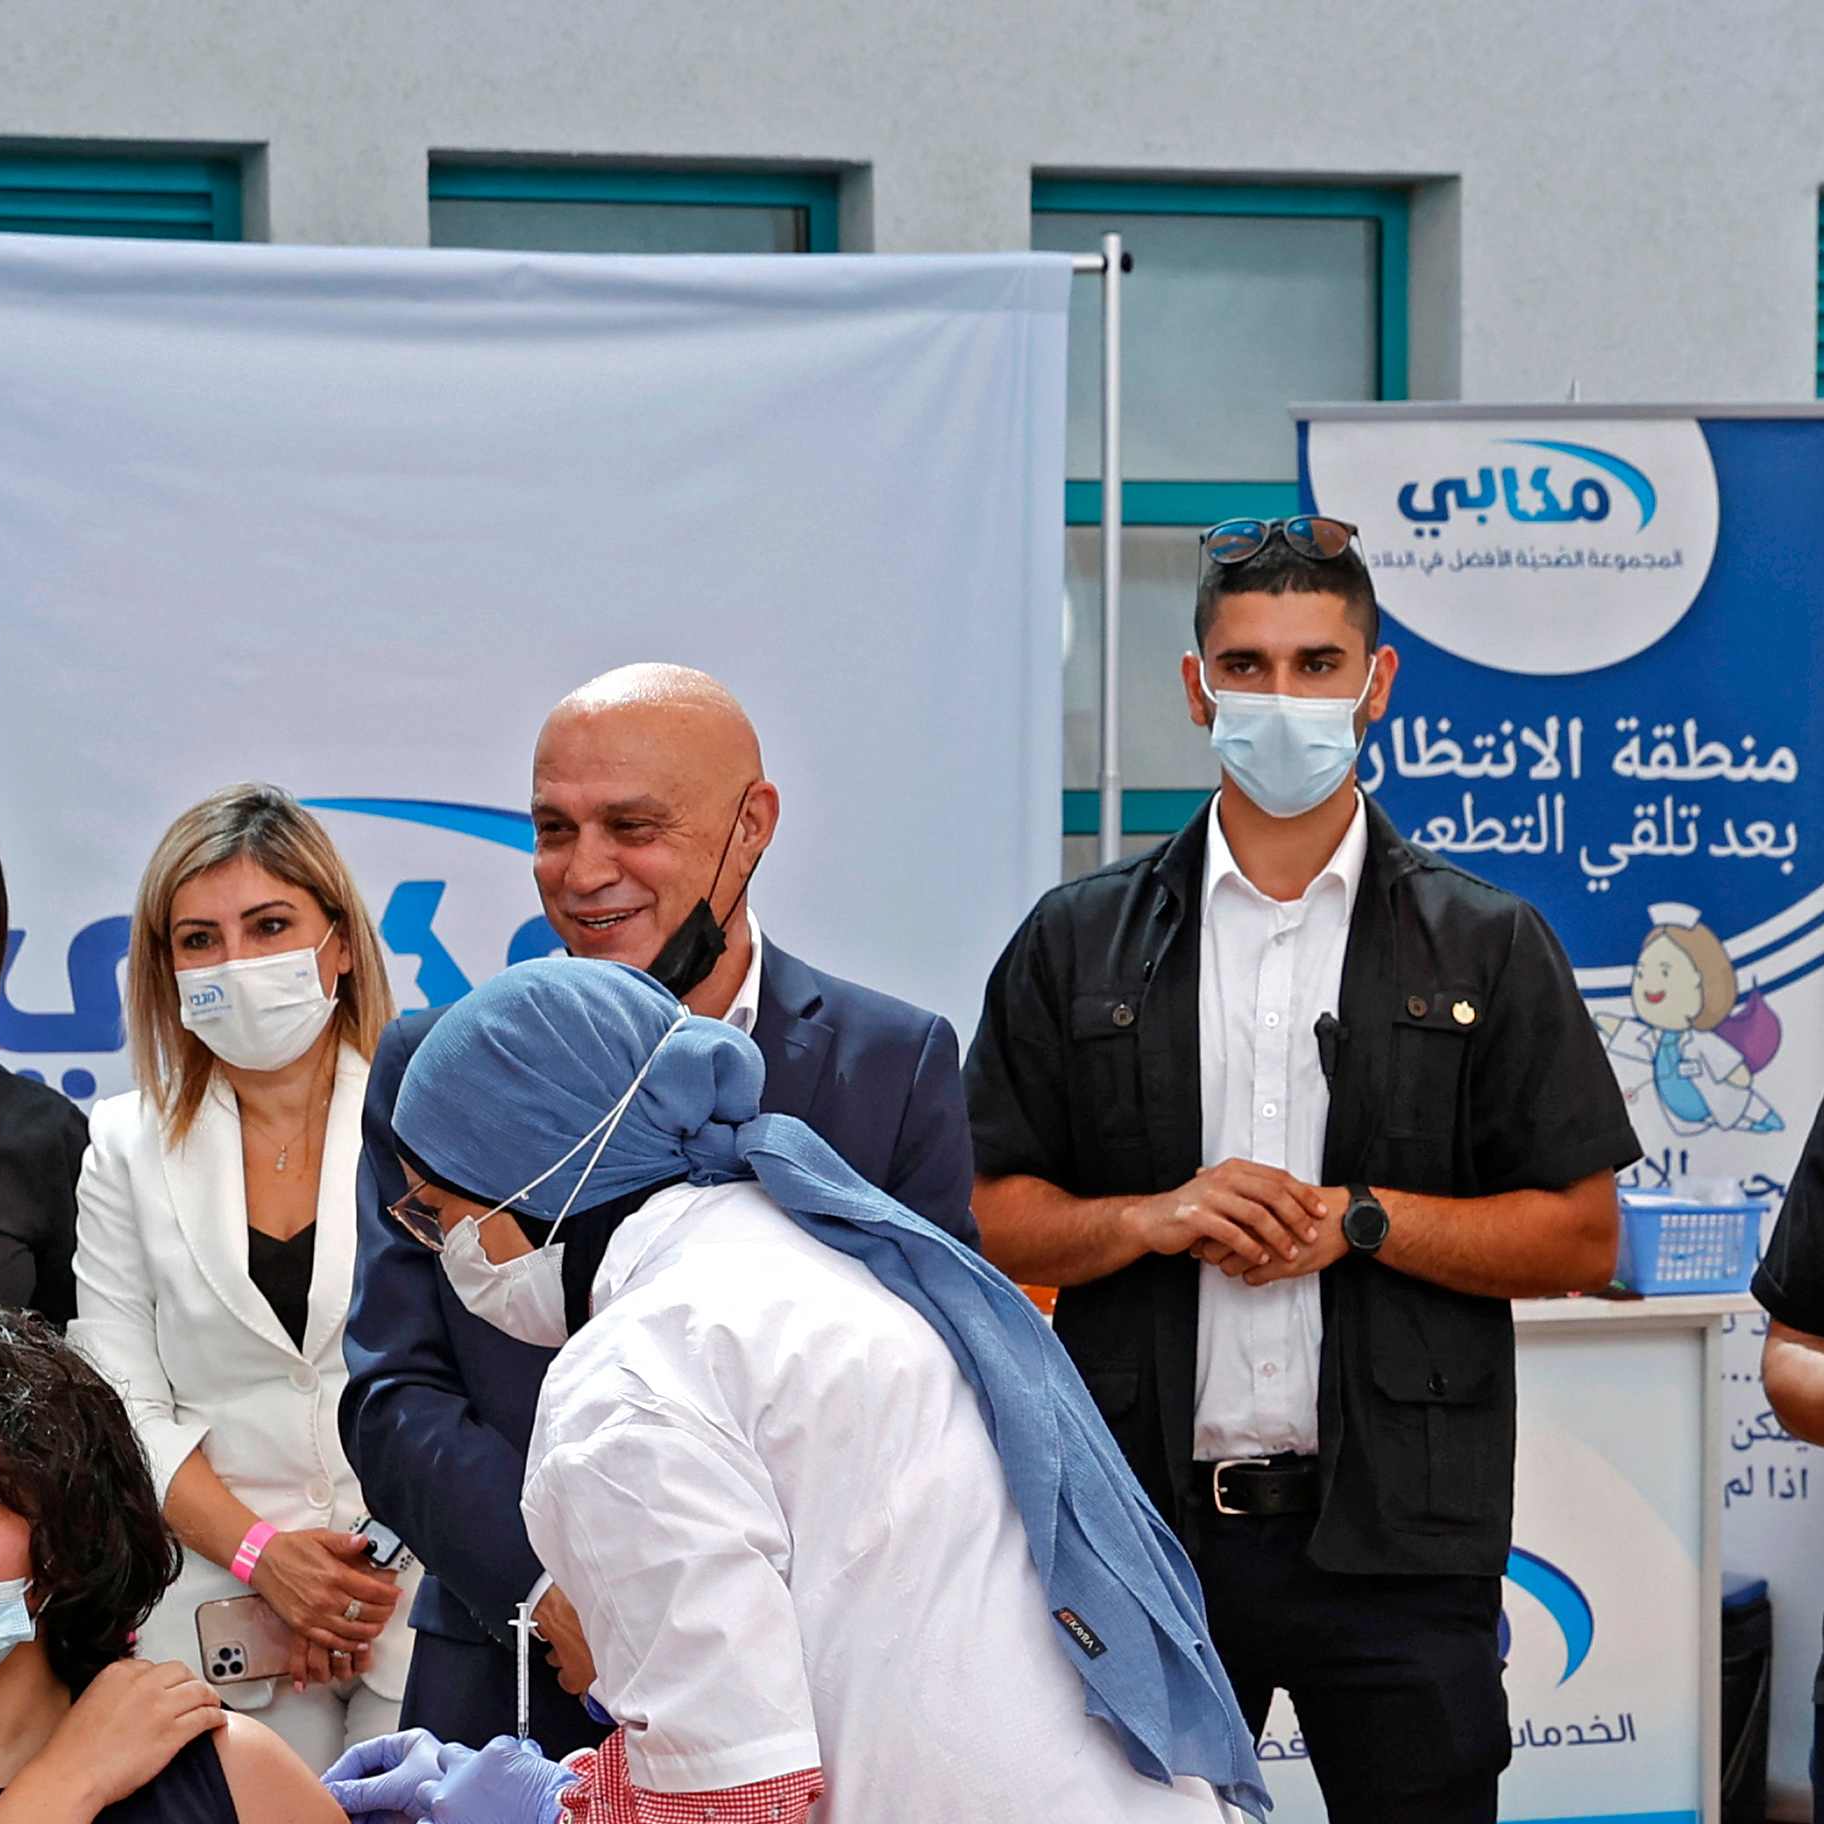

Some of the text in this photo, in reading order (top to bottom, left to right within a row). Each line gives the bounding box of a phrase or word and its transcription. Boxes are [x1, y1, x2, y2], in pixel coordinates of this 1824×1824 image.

[1397, 467, 1611, 538] مكابي
[1356, 716, 1799, 793] منطقة الانتظار
[1579, 795, 1701, 893] تلقي
[1708, 818, 1798, 875] بعد
